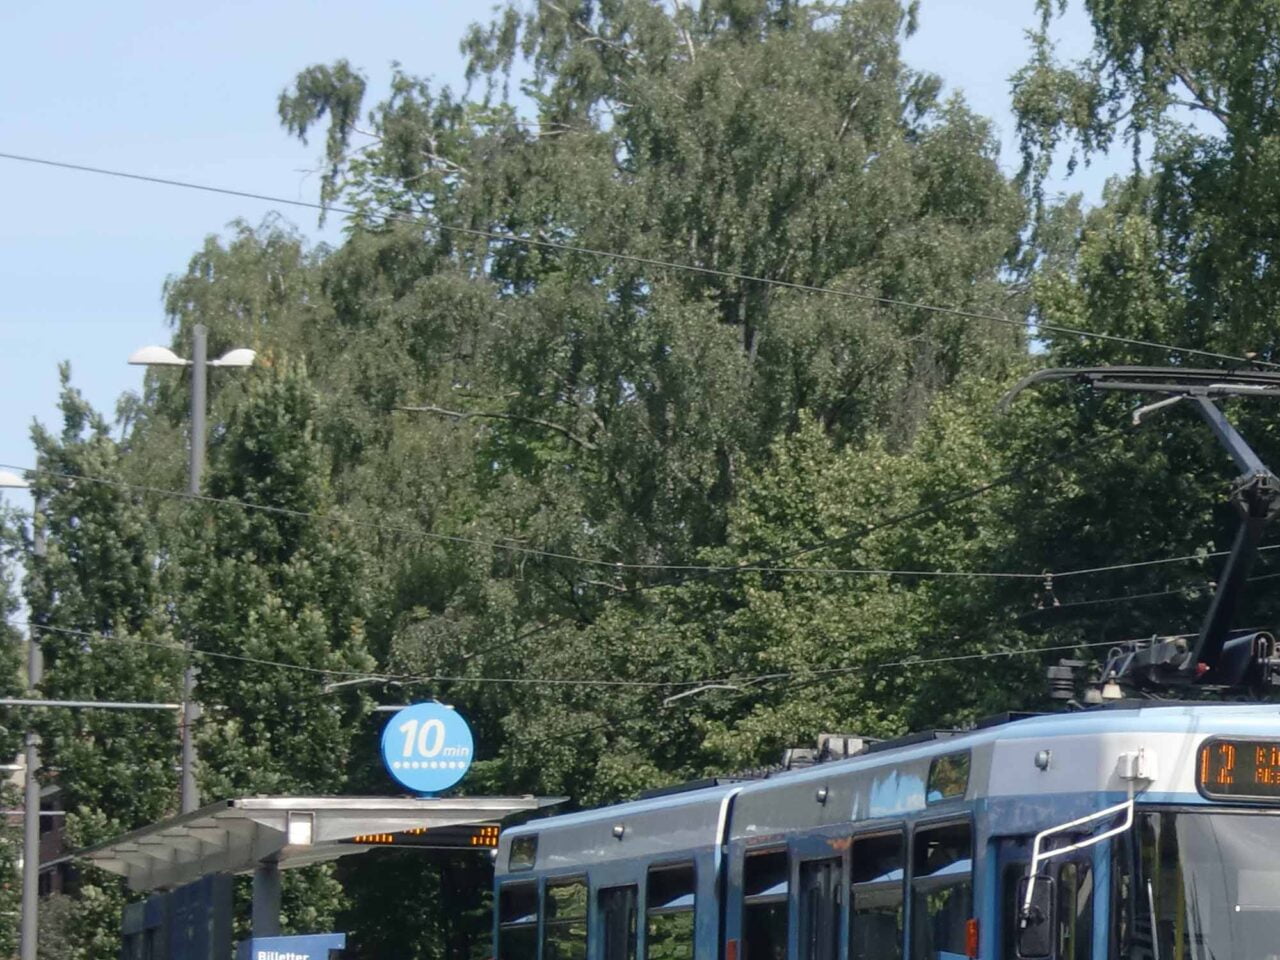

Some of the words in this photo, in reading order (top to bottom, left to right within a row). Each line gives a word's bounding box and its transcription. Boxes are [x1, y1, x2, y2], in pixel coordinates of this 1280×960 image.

[400, 719, 446, 758] 10
[443, 747, 469, 757] min
[1201, 744, 1235, 784] 12
